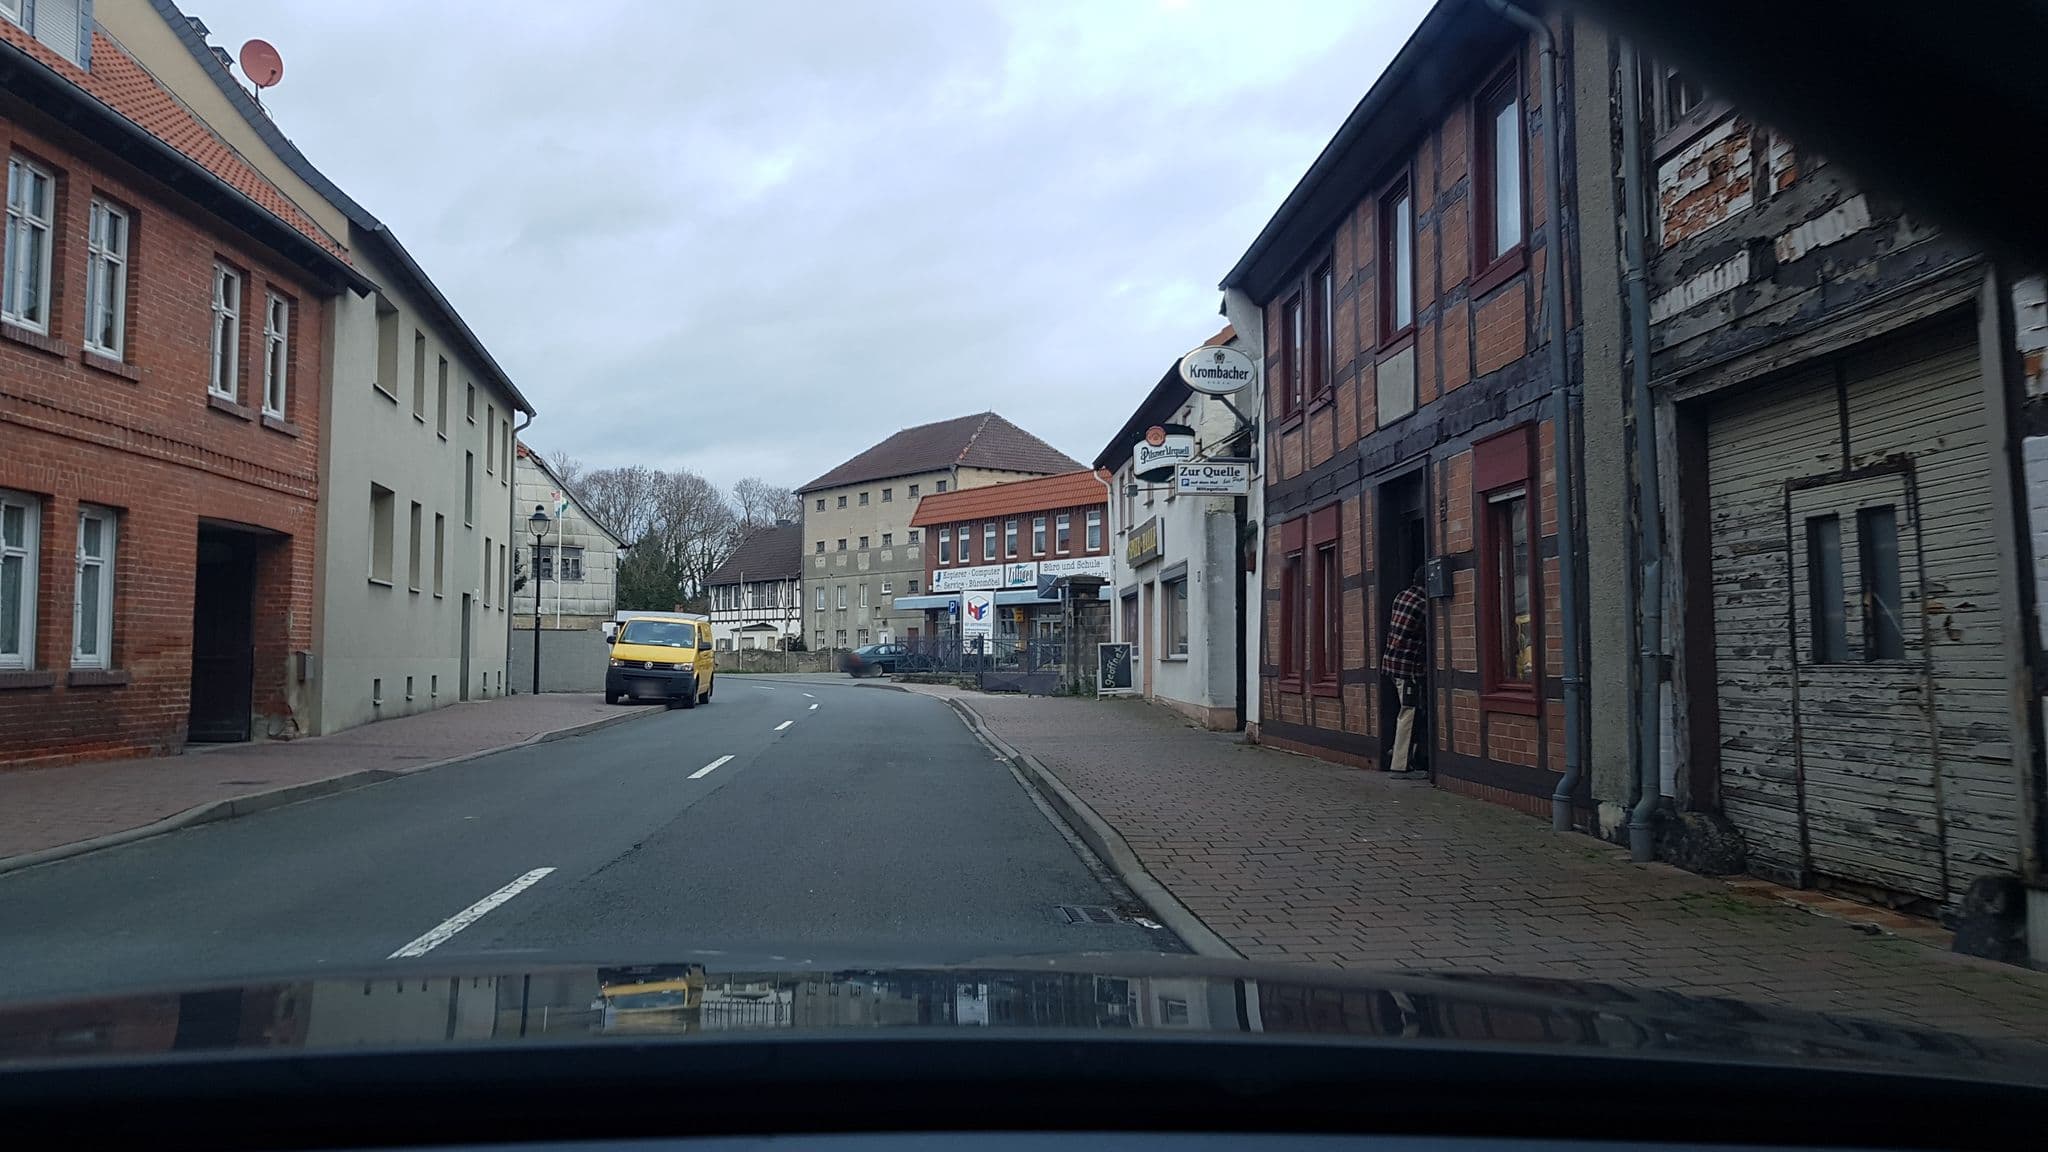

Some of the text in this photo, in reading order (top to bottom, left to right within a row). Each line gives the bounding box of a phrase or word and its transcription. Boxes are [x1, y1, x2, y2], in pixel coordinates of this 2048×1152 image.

[1190, 364, 1249, 380] Krombacher
[1140, 447, 1166, 464] Pilsner
[1180, 466, 1241, 478] Zur Quelle
[1044, 563, 1060, 571] Büro
[1061, 561, 1075, 570] und
[971, 568, 1001, 578] Computer
